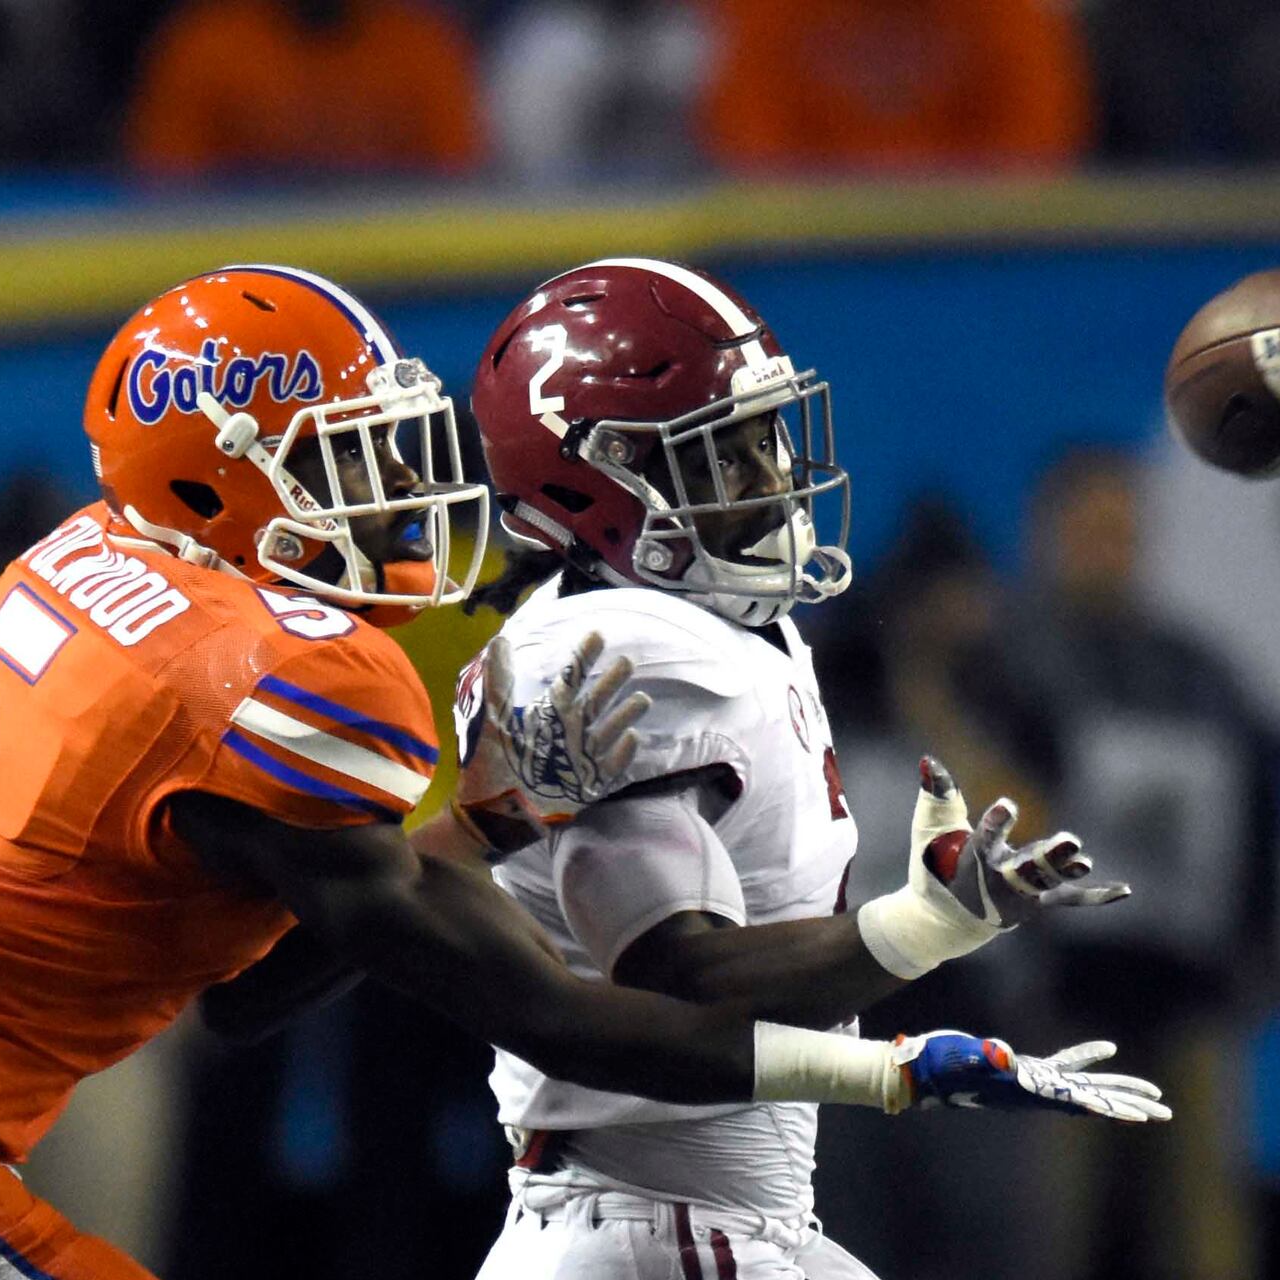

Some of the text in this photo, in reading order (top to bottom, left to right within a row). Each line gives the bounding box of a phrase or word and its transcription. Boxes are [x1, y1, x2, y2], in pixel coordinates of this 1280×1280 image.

[128, 338, 323, 425] Gators
[529, 324, 568, 415] 2
[253, 583, 358, 641] 5
